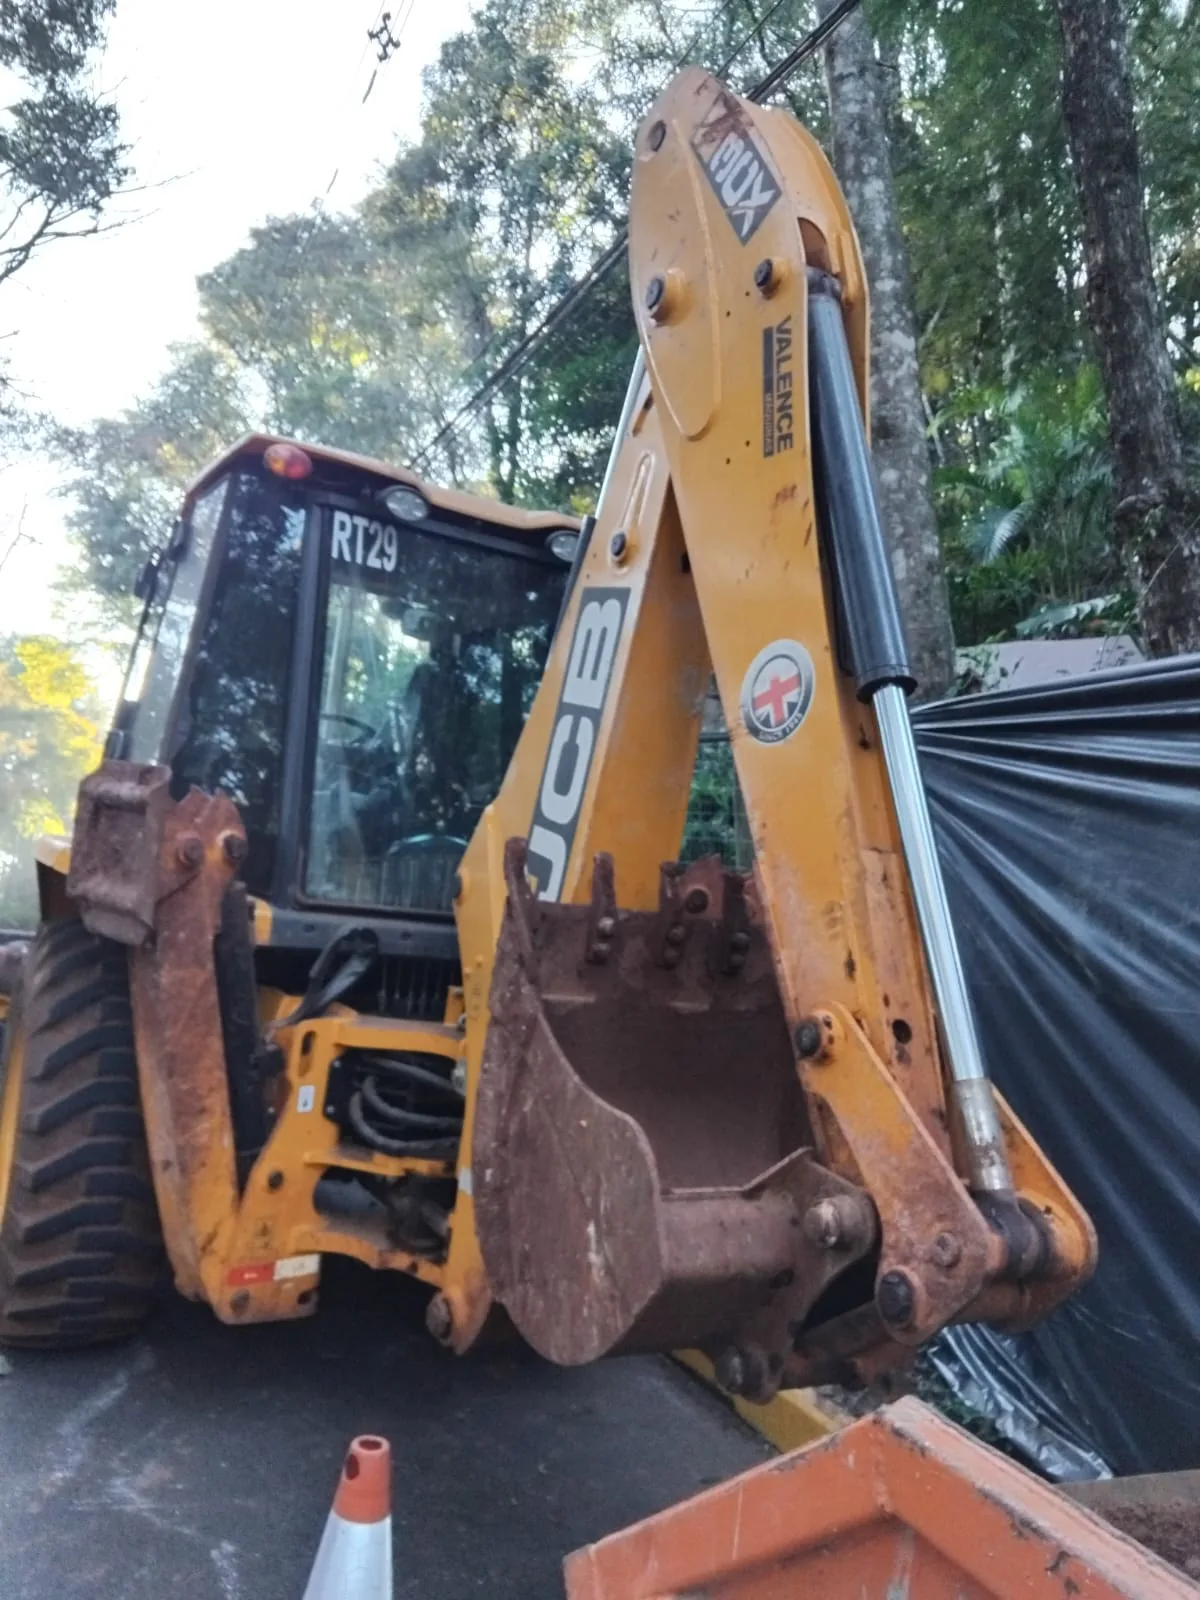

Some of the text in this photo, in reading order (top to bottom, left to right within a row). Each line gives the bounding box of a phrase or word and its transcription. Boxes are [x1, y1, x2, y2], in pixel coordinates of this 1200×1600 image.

[710, 132, 776, 237] 3CX
[776, 314, 793, 454] VALENCE
[331, 510, 398, 572] RT29
[526, 598, 621, 902] JCB
